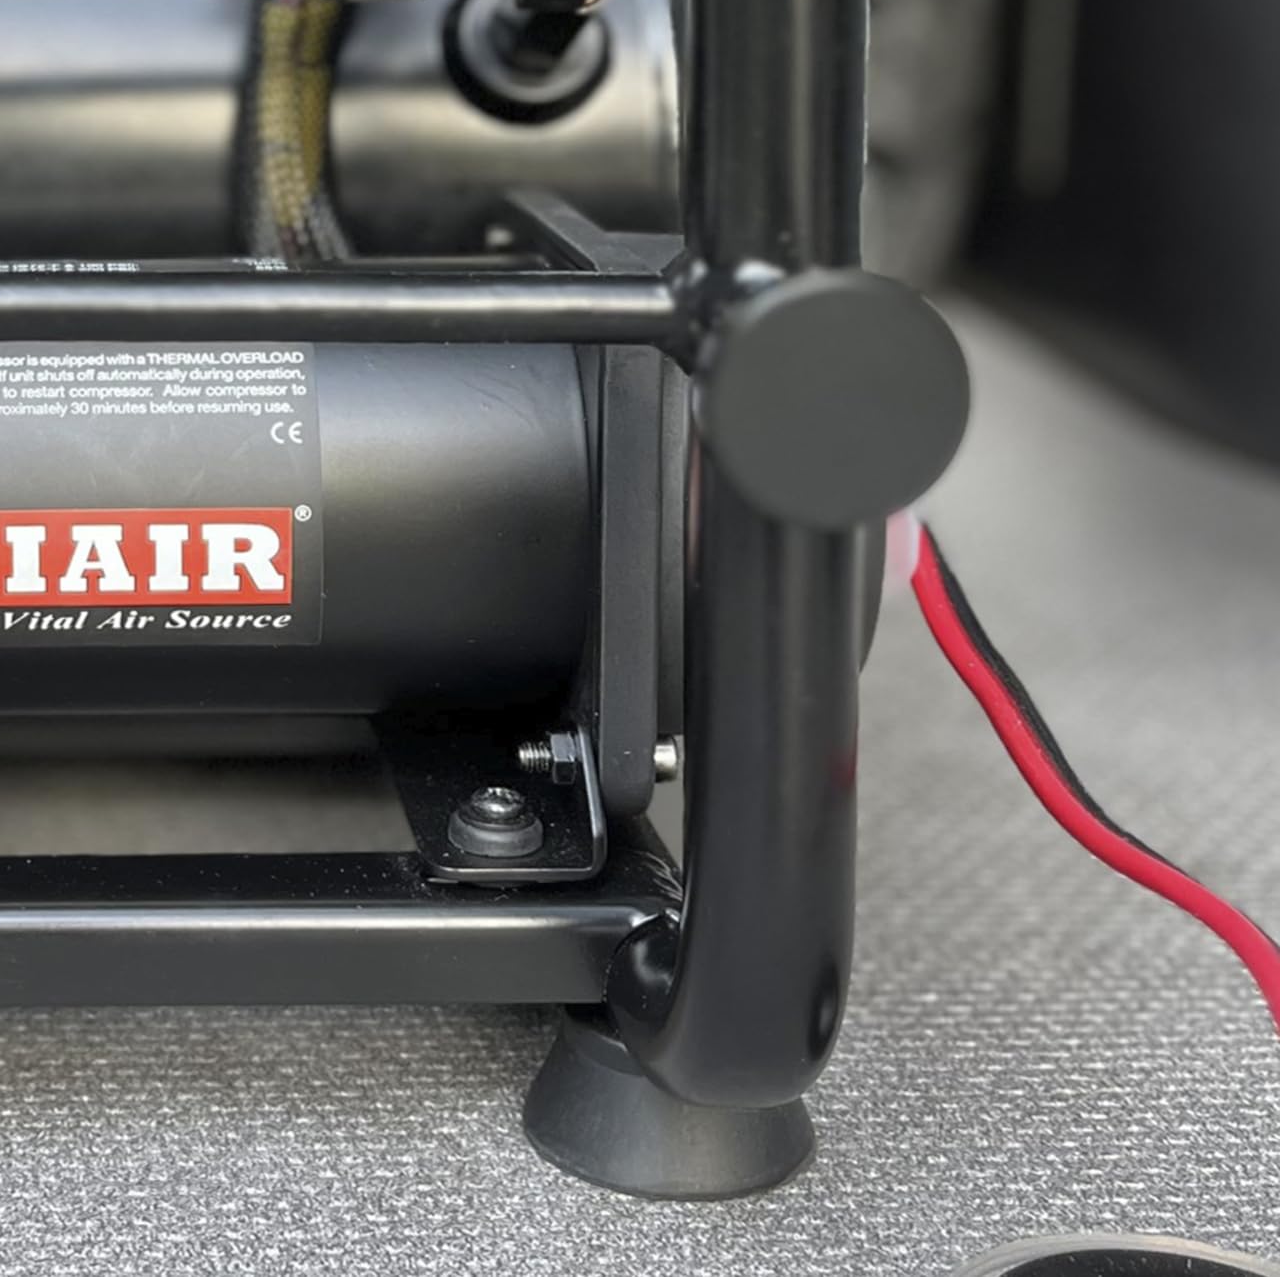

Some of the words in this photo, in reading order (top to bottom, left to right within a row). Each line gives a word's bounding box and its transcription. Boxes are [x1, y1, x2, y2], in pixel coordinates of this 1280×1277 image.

[27, 355, 38, 366] is
[40, 354, 104, 368] equipped
[106, 353, 135, 365] with
[136, 355, 146, 365] a
[147, 352, 219, 365] THERMAL
[220, 351, 304, 364] OVERLOAD
[9, 370, 35, 382] unit
[36, 369, 75, 382] shuts
[77, 369, 95, 381] off
[97, 368, 188, 383] automatically
[189, 368, 234, 382] during
[235, 367, 305, 382] operation,
[3, 386, 17, 398] to
[21, 386, 65, 398] restart
[69, 386, 153, 399] compressor.
[163, 384, 201, 397] Allow
[205, 386, 288, 398] compressor
[291, 384, 307, 396] to
[71, 402, 89, 415] 30
[92, 401, 147, 414] minutes
[150, 401, 194, 413] before
[197, 401, 261, 415] resuming
[264, 402, 294, 413] use.
[3, 611, 89, 630] Vital
[97, 610, 155, 630] Air
[165, 610, 292, 629] Source
